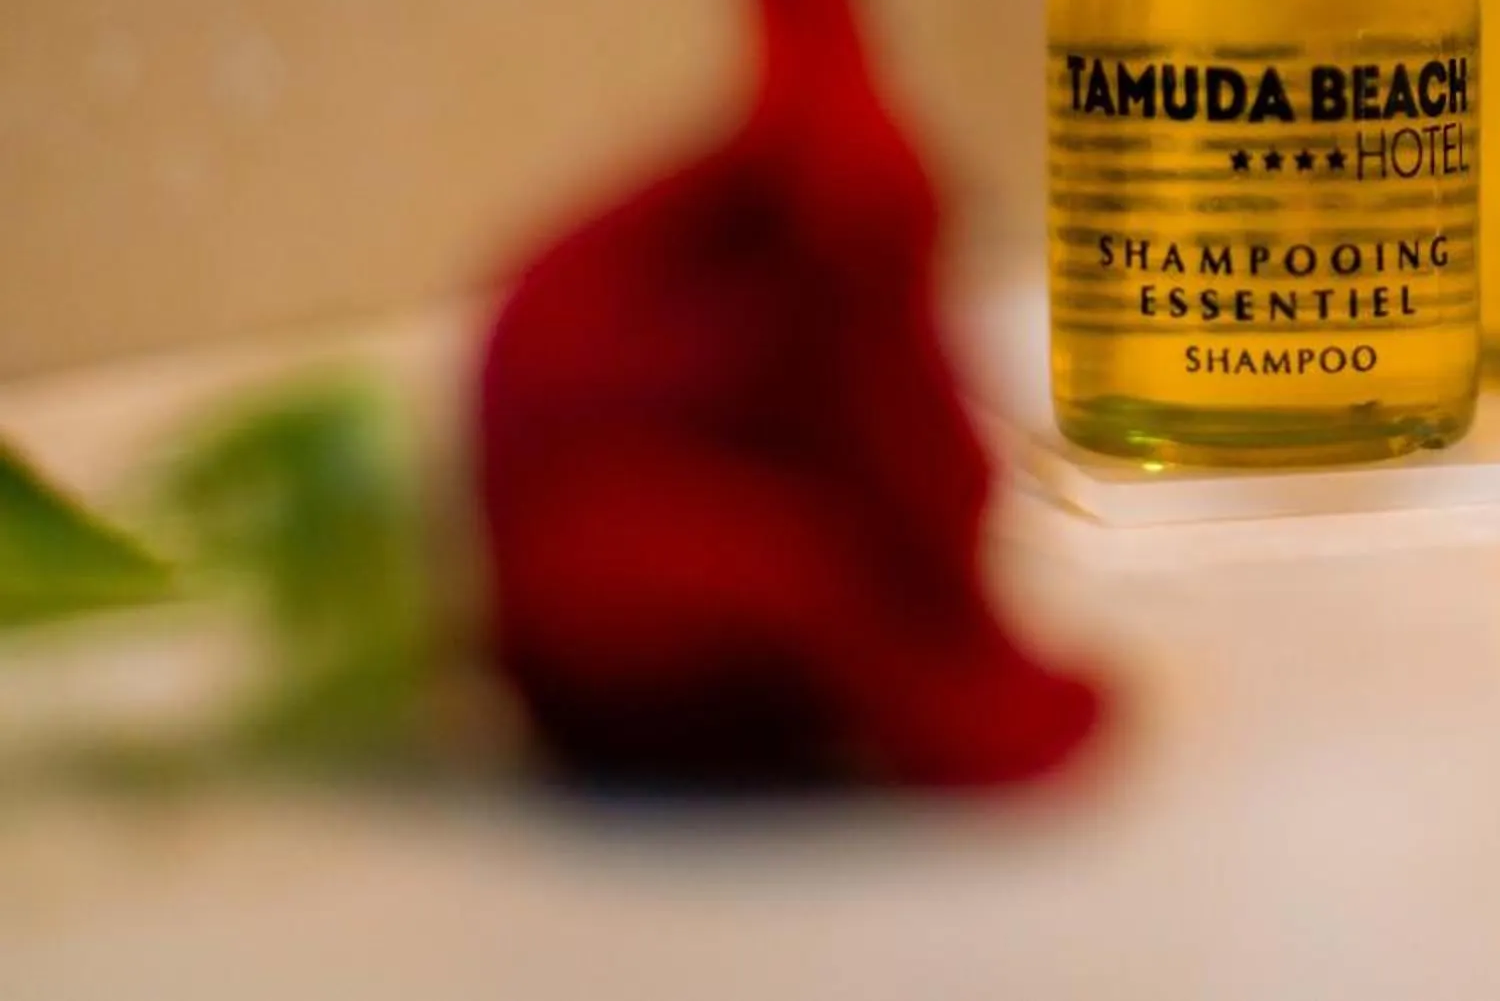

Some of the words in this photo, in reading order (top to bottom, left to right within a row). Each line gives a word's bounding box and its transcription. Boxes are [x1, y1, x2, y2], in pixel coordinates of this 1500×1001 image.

[1067, 55, 1295, 123] TAMUDA
[1311, 57, 1468, 123] BEACH
[1356, 123, 1470, 180] HOTEL
[1099, 235, 1449, 276] SHAMPOOING
[1140, 285, 1416, 321] ESSENTIEL
[1185, 345, 1377, 375] SHAMPOO
